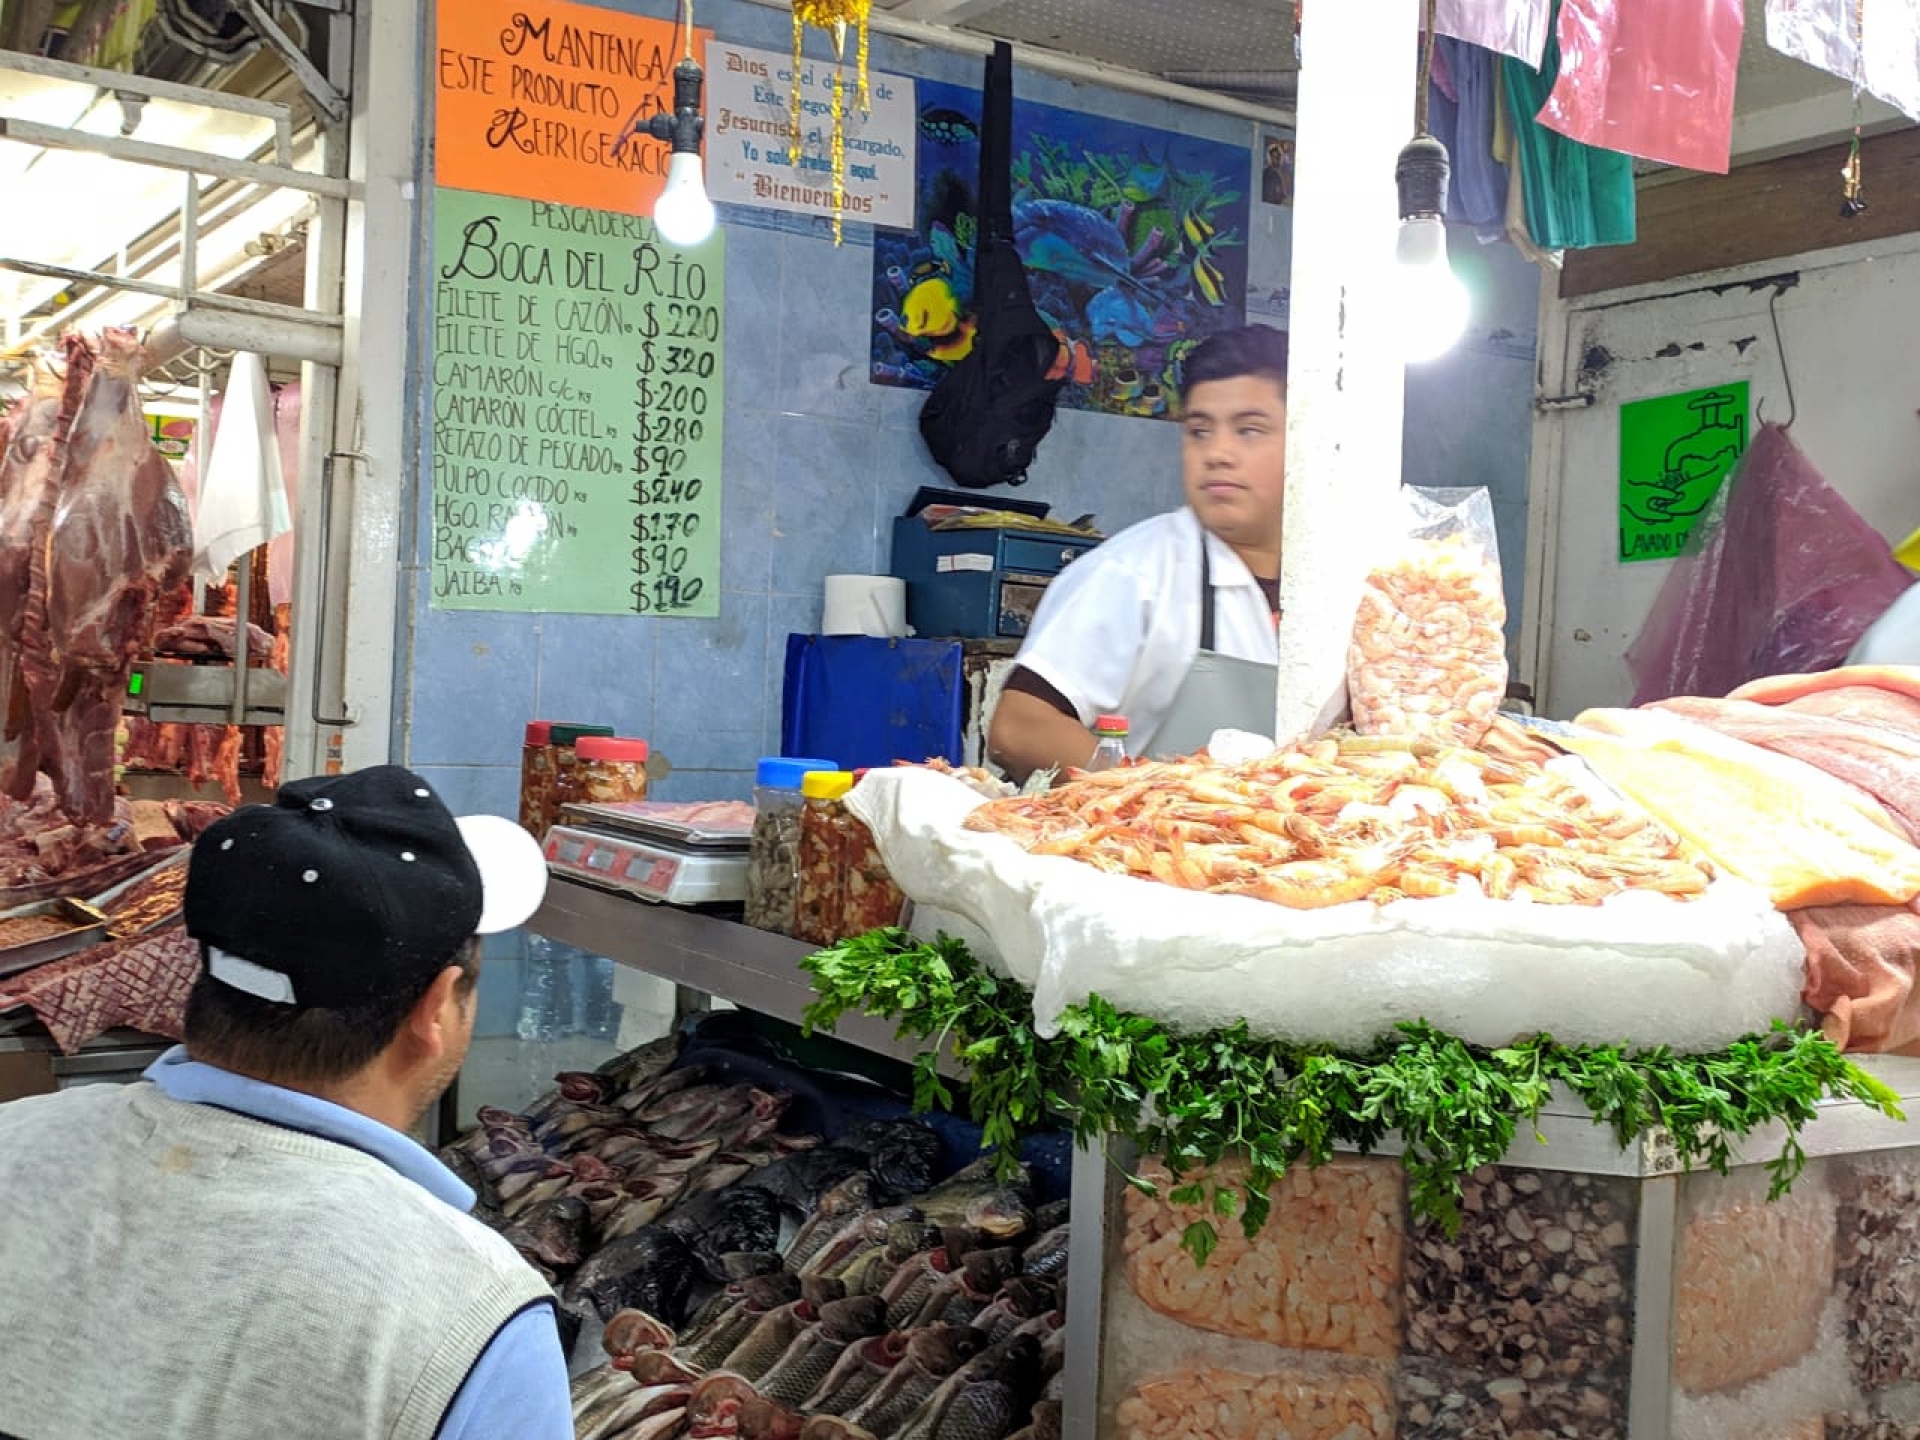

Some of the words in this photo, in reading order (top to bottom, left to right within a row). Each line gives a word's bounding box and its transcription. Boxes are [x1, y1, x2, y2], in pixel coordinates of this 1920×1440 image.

[500, 13, 667, 85] MANTENGA
[440, 48, 495, 95] ESTE
[511, 65, 620, 118] PRODUCTO
[726, 52, 768, 77] Dios
[777, 70, 792, 82] es
[801, 65, 814, 86] el
[876, 84, 893, 101] de
[754, 84, 783, 107] Este
[743, 140, 758, 161] Yo
[808, 127, 822, 145] el
[753, 174, 874, 214] Bienvendos
[441, 216, 553, 285] BOCA
[566, 250, 614, 292] DEL
[624, 243, 706, 301] RÍO
[437, 281, 504, 322] FILETE
[518, 294, 541, 328] DE
[435, 316, 504, 358] FILETE
[516, 331, 541, 362] DE
[433, 353, 543, 398] CAMARÓN
[434, 388, 525, 429] CAMARÓN
[536, 402, 603, 438] CÓCTEL
[434, 419, 501, 462] RETAZO
[510, 435, 529, 466] DE
[539, 438, 613, 475] PESCADO
[433, 454, 490, 496] PULPO
[435, 564, 502, 597] JAIBA
